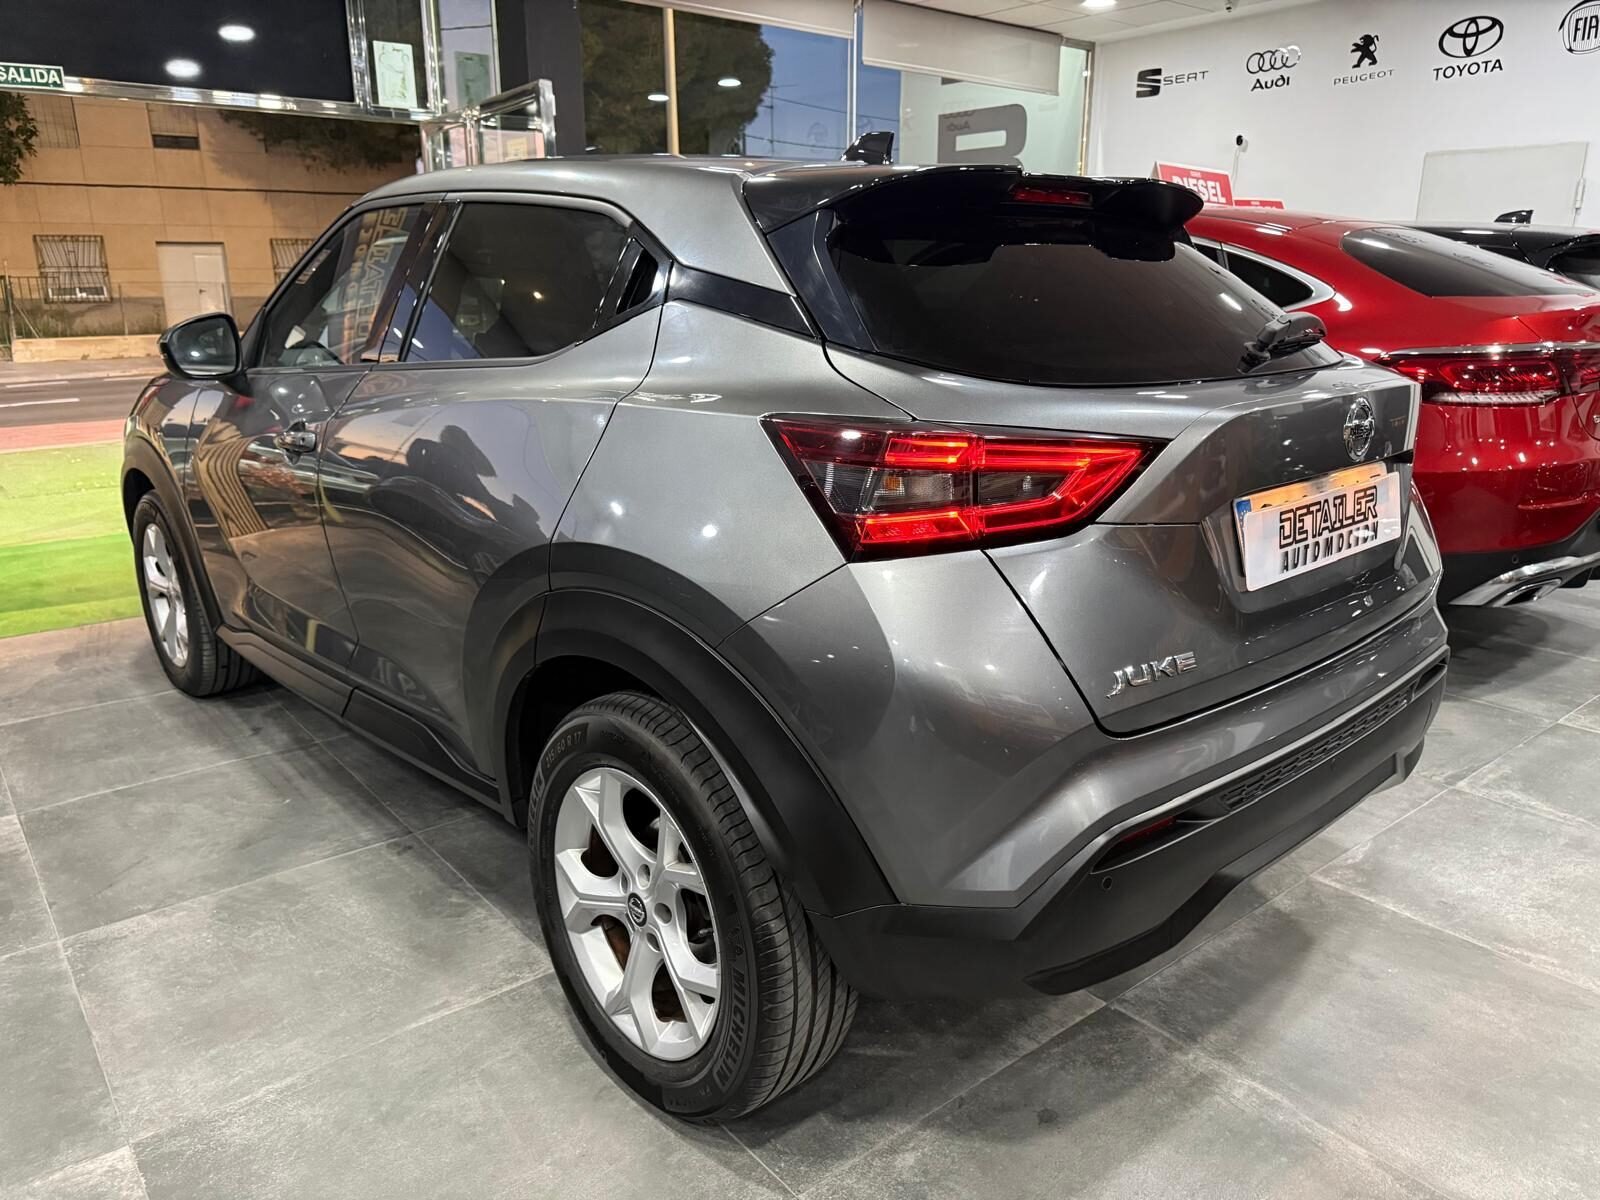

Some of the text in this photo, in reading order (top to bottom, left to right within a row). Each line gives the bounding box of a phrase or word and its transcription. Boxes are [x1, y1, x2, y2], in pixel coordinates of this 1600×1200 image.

[0, 66, 61, 84] SALIDA
[1163, 71, 1209, 86] SEAT
[1333, 69, 1395, 86] PEUGEOT
[1433, 59, 1503, 81] TOYOTA
[1250, 75, 1290, 92] Audi
[1280, 485, 1378, 549] DETAILER
[1106, 651, 1197, 699] JUKE
[713, 966, 746, 1088] MICHELIN
